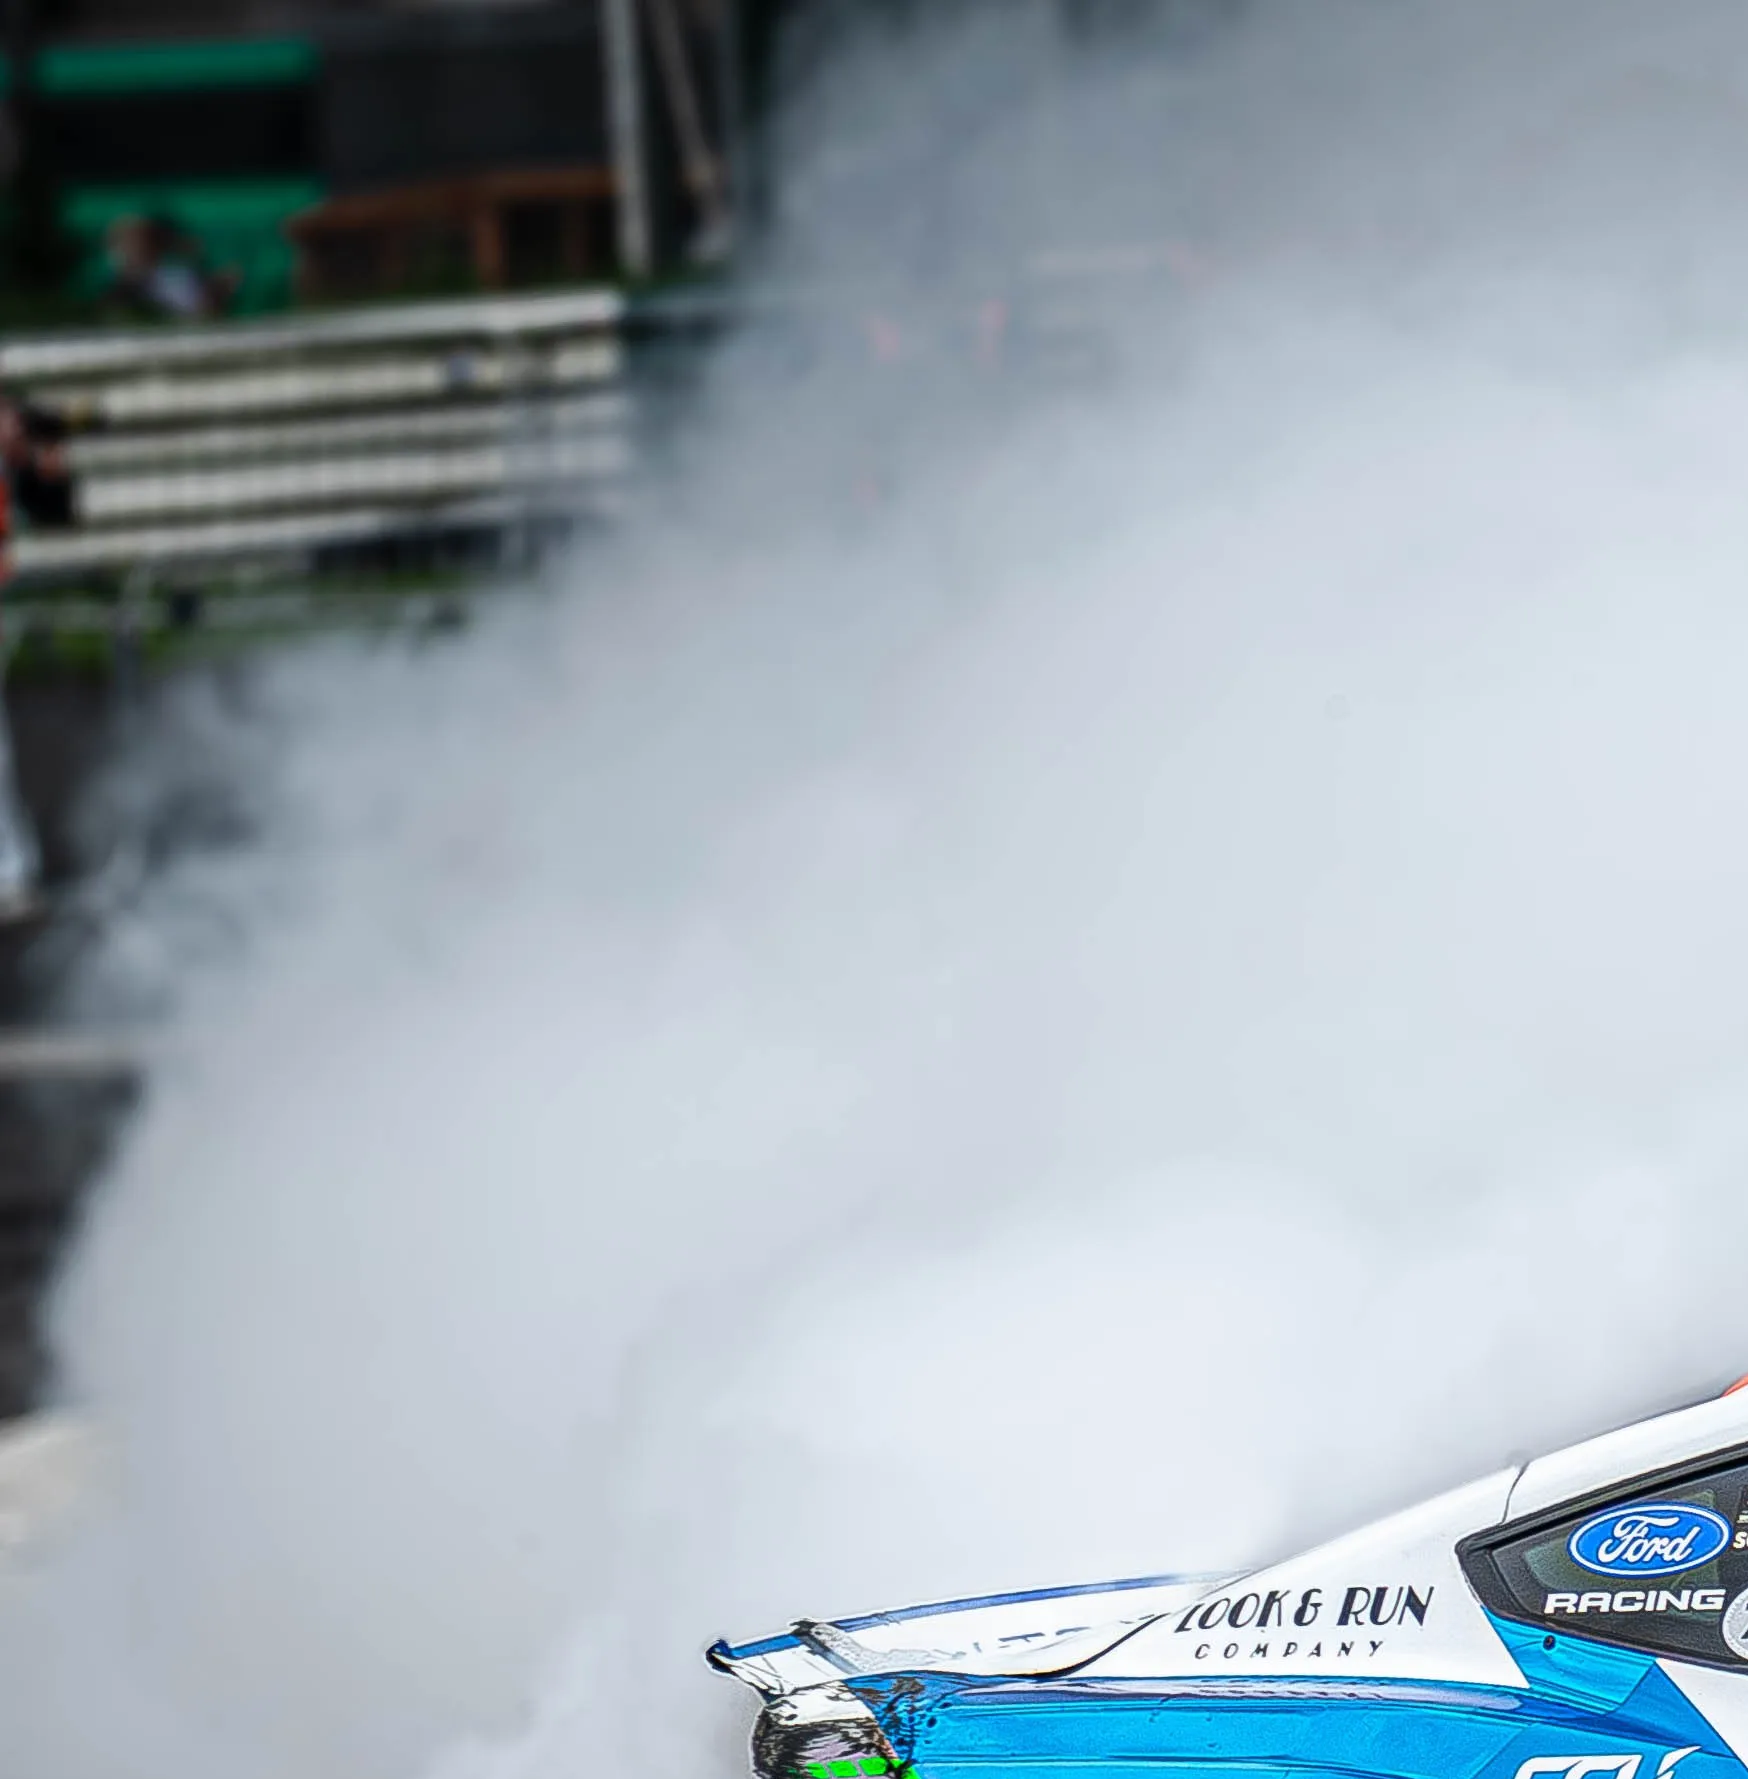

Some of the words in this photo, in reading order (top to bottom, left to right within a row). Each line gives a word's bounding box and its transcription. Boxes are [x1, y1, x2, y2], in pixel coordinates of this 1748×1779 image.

[1597, 1513, 1693, 1563] Ford
[1174, 1590, 1291, 1633] LOOK
[1336, 1585, 1434, 1626] RUN
[1545, 1588, 1726, 1614] RACING
[1194, 1640, 1383, 1660] COMPANY
